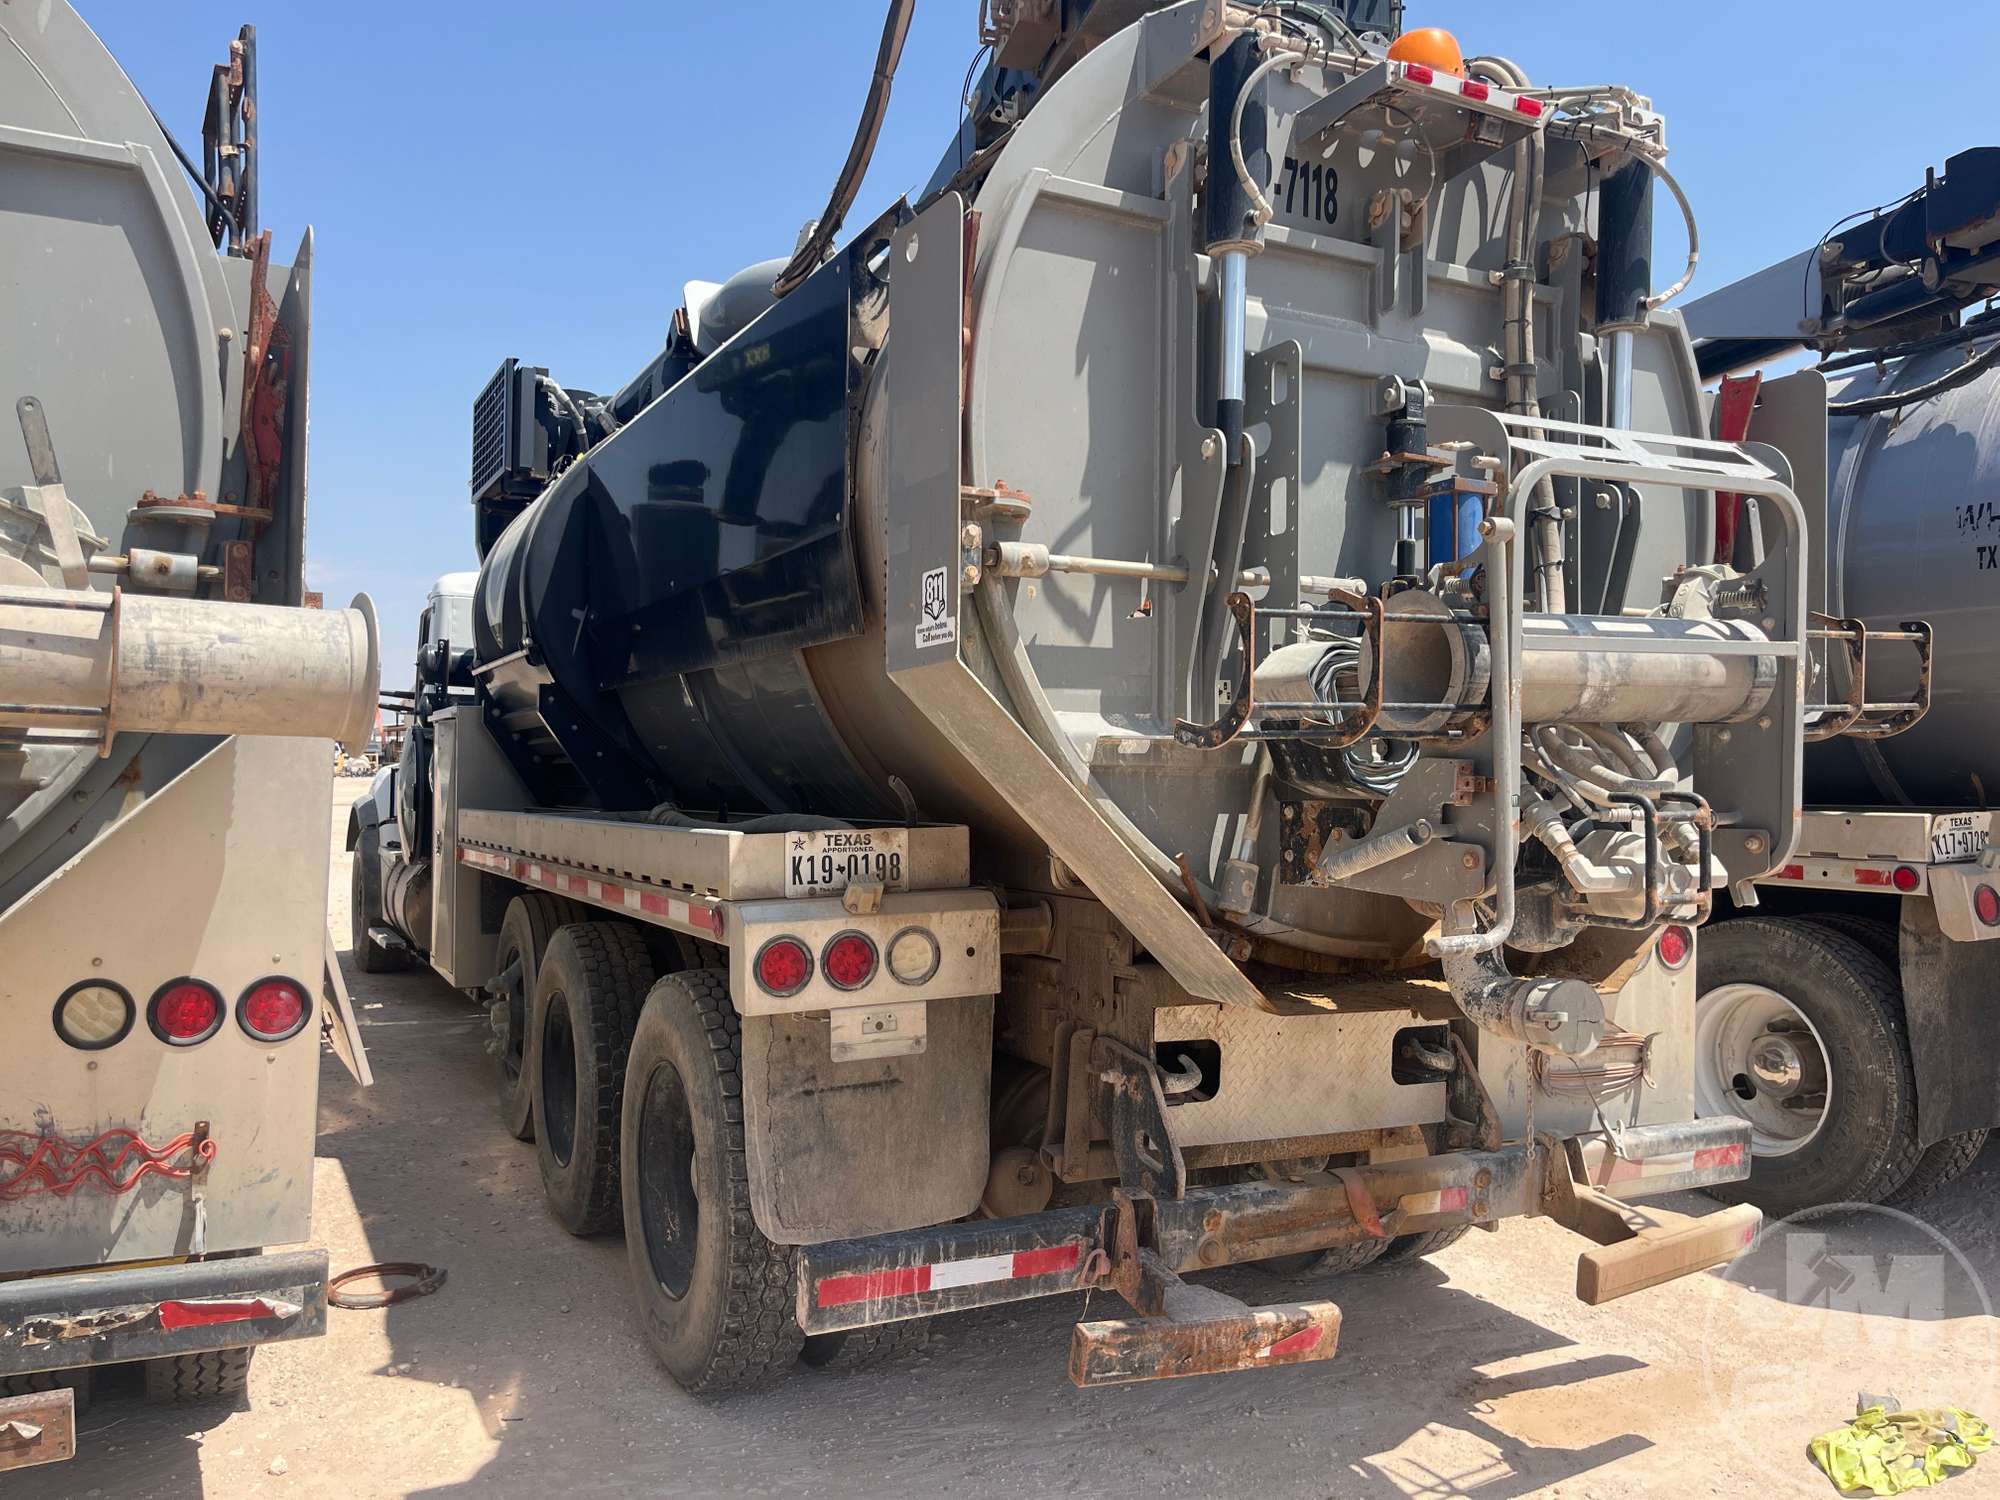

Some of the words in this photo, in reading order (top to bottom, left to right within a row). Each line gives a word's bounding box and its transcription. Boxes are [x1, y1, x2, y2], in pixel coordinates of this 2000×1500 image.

[1265, 152, 1338, 224] -7118
[1977, 545, 1997, 569] TX
[925, 572, 943, 605] 811
[1950, 817, 1972, 826] TEXAS
[825, 834, 872, 846] TEXAS
[792, 855, 833, 885] K19
